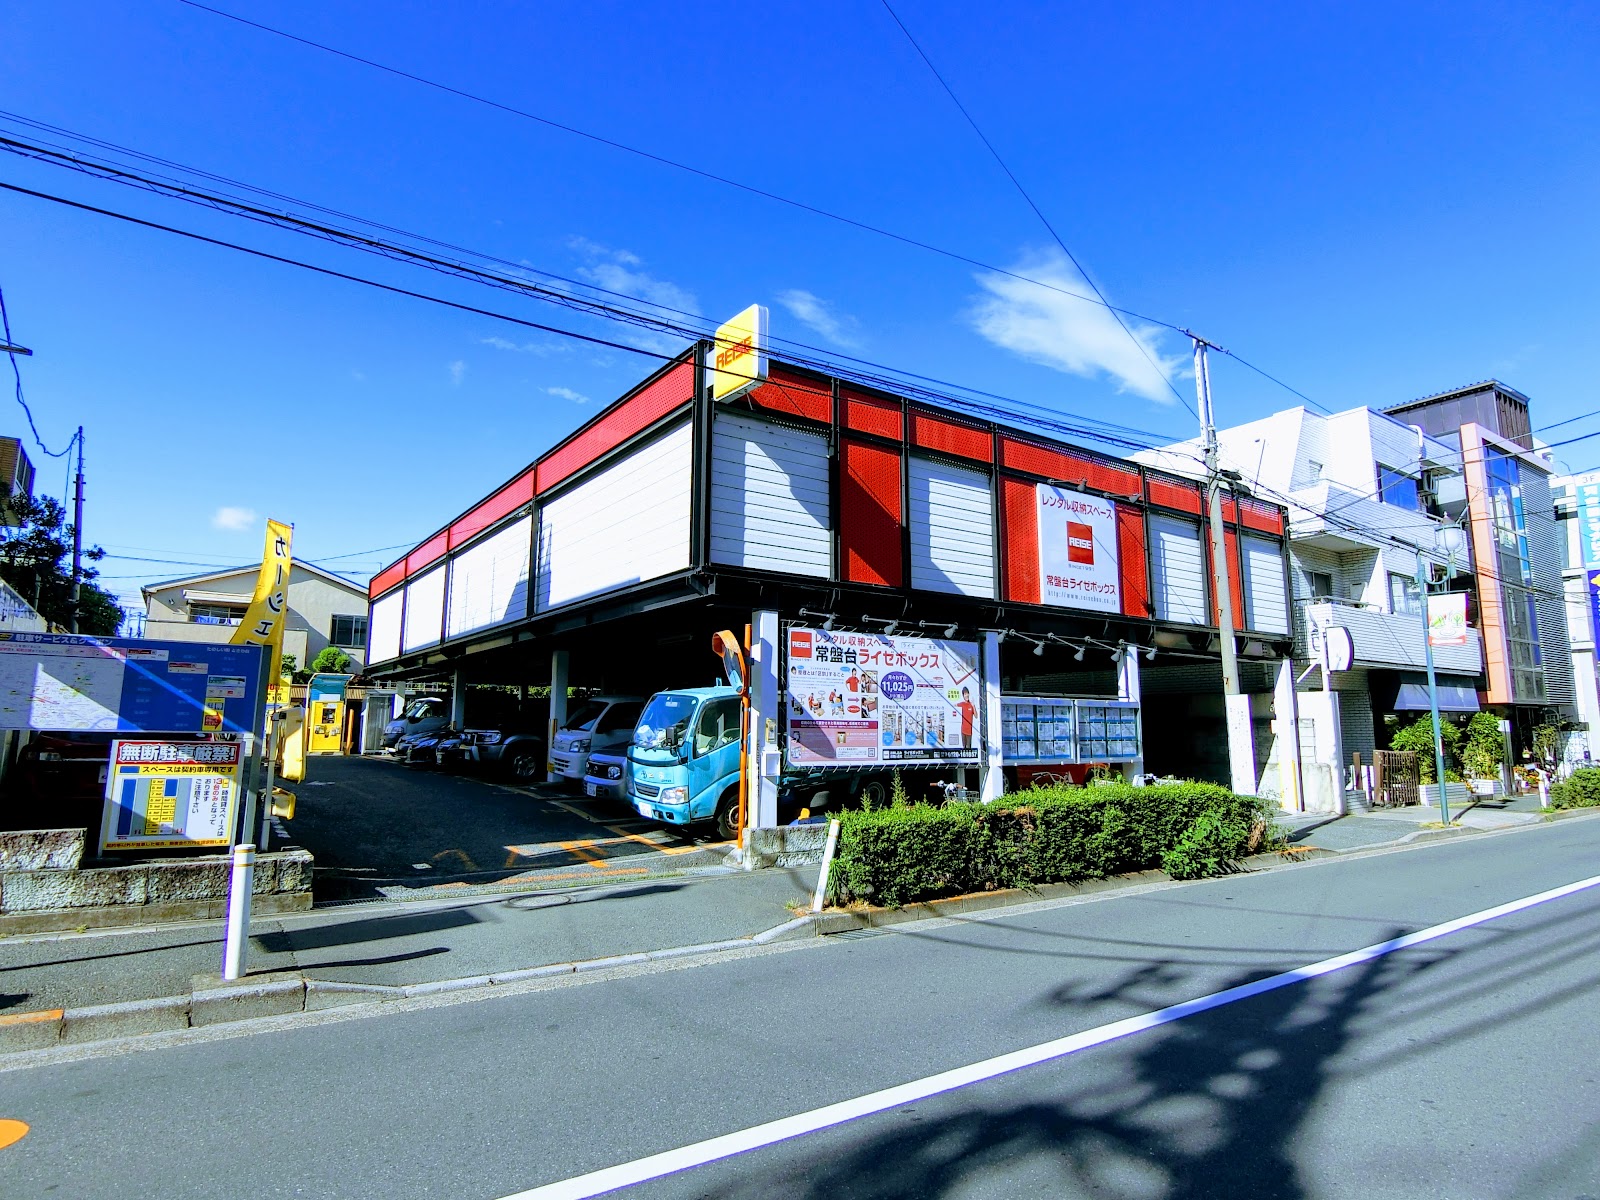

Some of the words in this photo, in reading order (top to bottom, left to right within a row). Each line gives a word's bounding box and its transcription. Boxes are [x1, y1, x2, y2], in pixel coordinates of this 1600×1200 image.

[1041, 493, 1113, 519] レンタル収納スペース
[1068, 537, 1092, 550] REISE
[1046, 574, 1117, 595] 常盤台ライゼボックス
[815, 634, 895, 648] レンタル収納スペース
[120, 743, 236, 762] 無断駐車厳禁!
[142, 765, 234, 774] スペースは契約車専用です
[203, 778, 211, 802] おります
